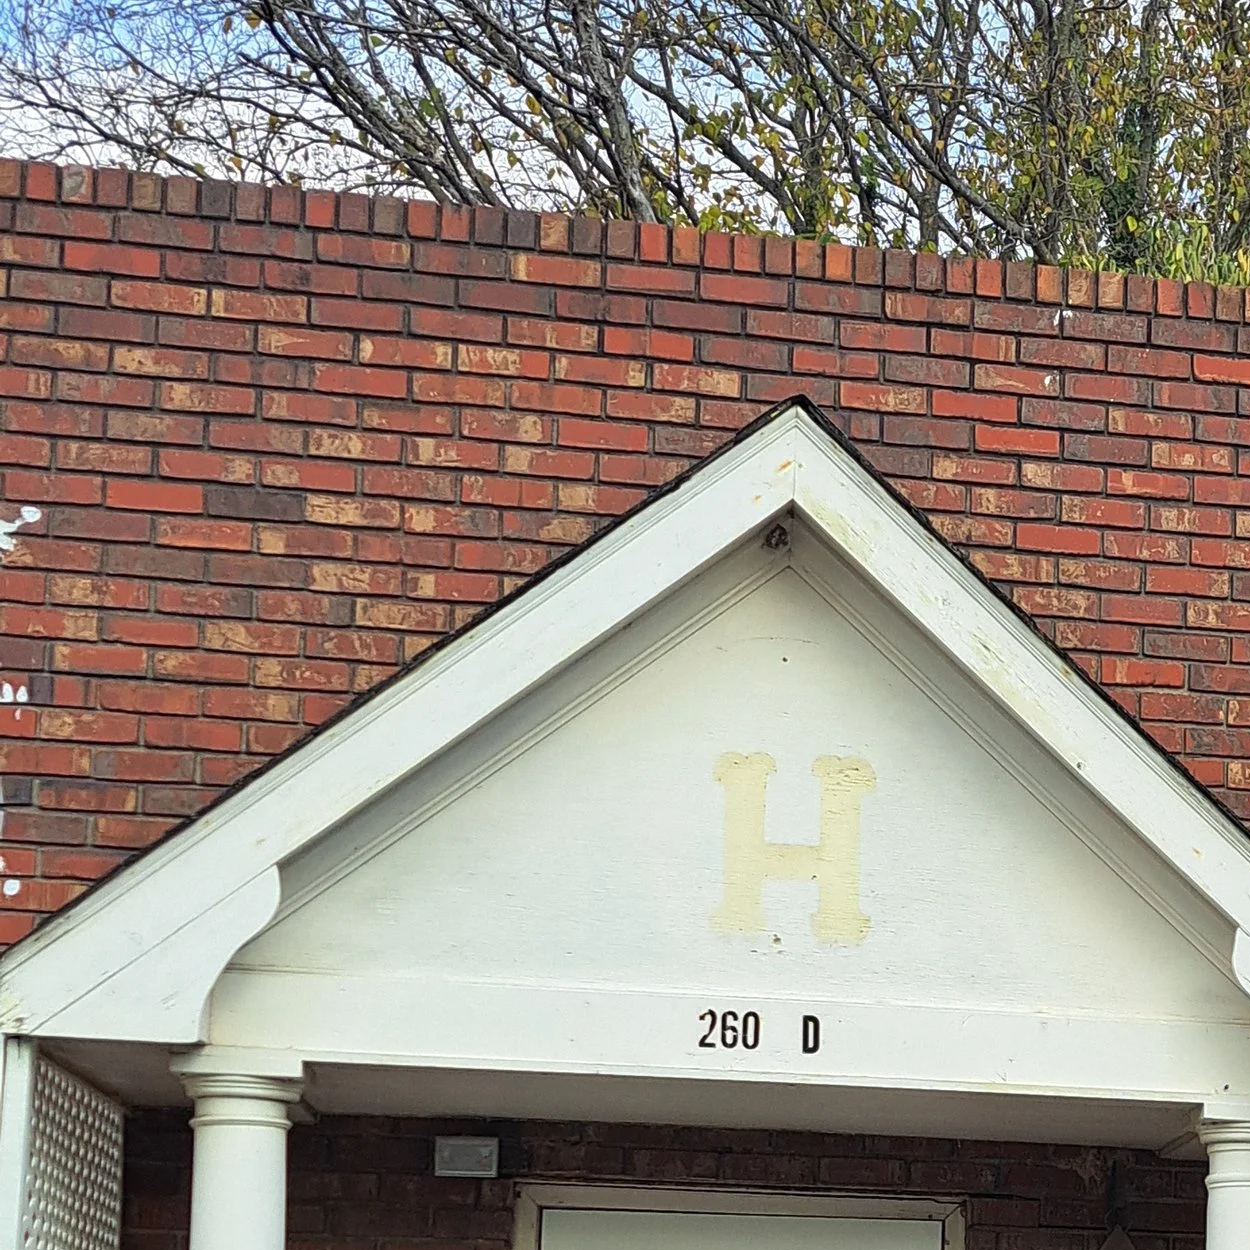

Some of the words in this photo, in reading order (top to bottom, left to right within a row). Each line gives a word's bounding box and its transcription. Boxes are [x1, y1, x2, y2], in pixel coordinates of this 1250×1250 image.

[708, 751, 877, 946] H
[698, 1009, 760, 1050] 260
[802, 1015, 820, 1054] D
